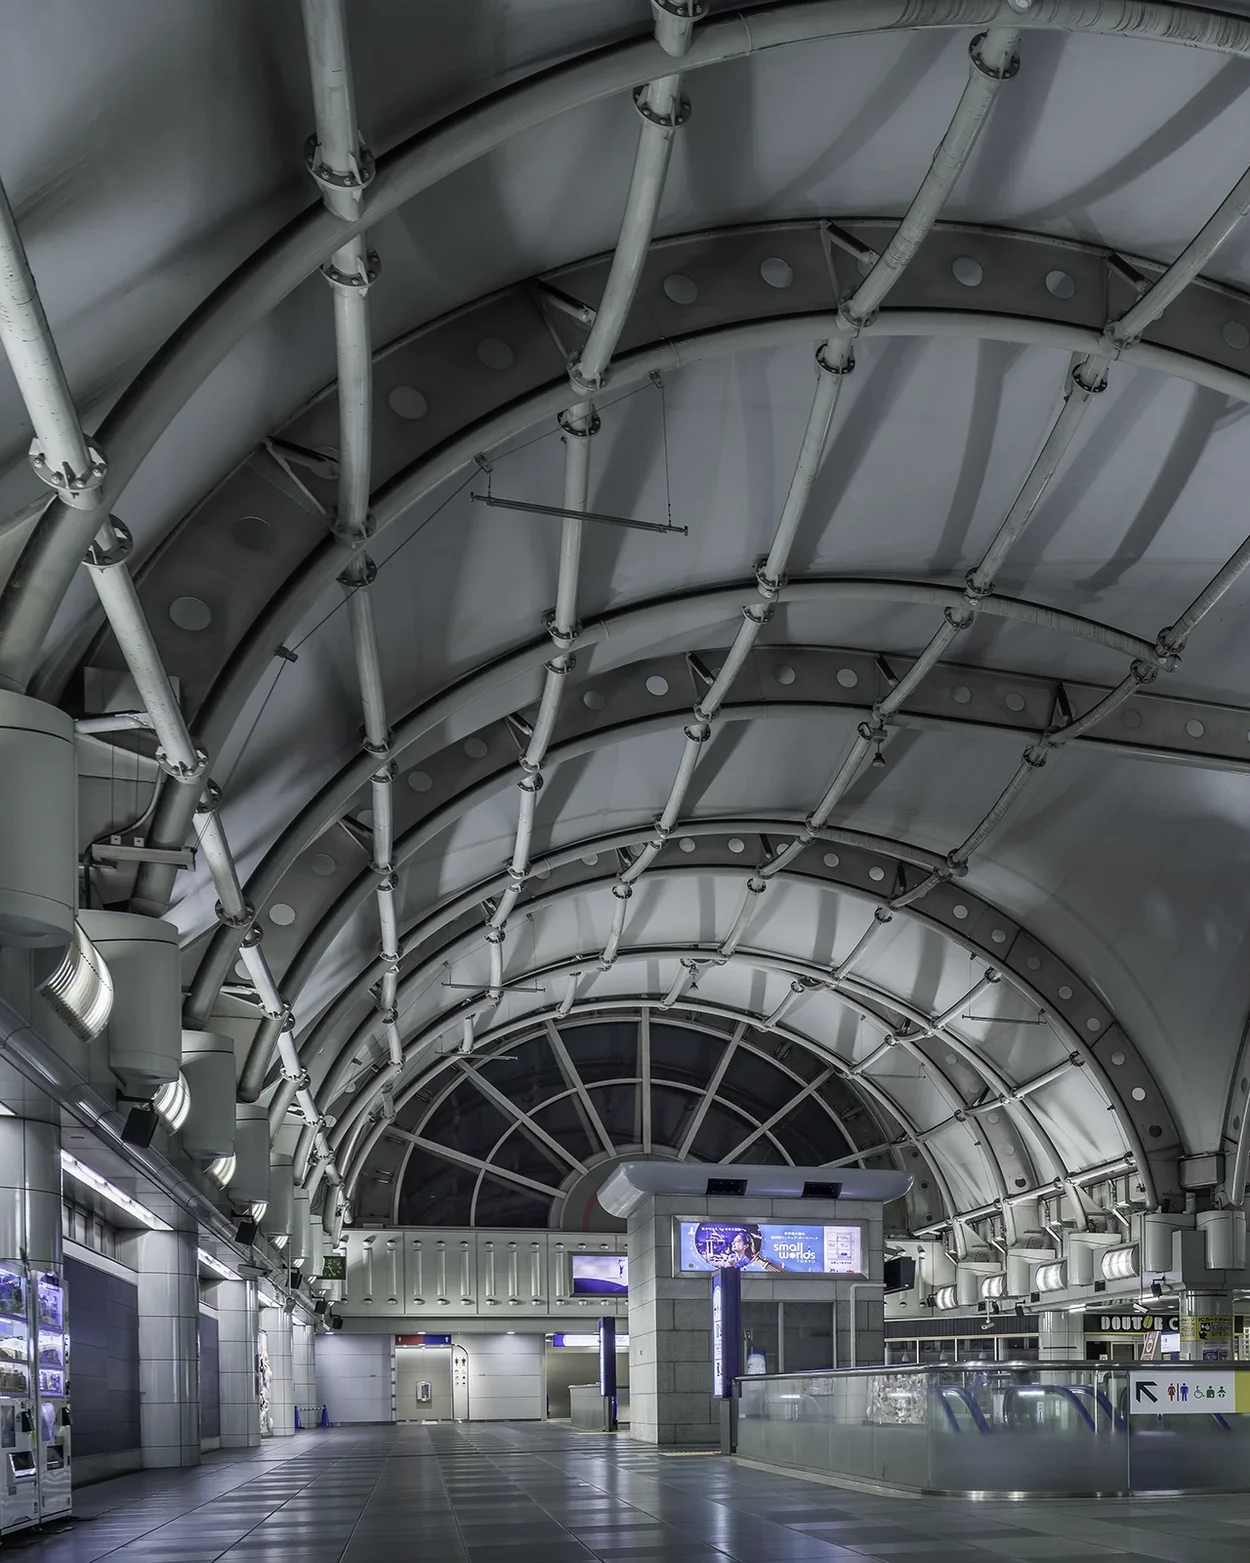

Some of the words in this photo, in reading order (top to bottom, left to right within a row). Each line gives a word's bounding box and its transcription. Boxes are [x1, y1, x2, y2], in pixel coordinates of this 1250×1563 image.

[773, 1242, 803, 1252] small
[778, 1249, 816, 1260] worlds
[1101, 1316, 1162, 1330] DOUTOR
